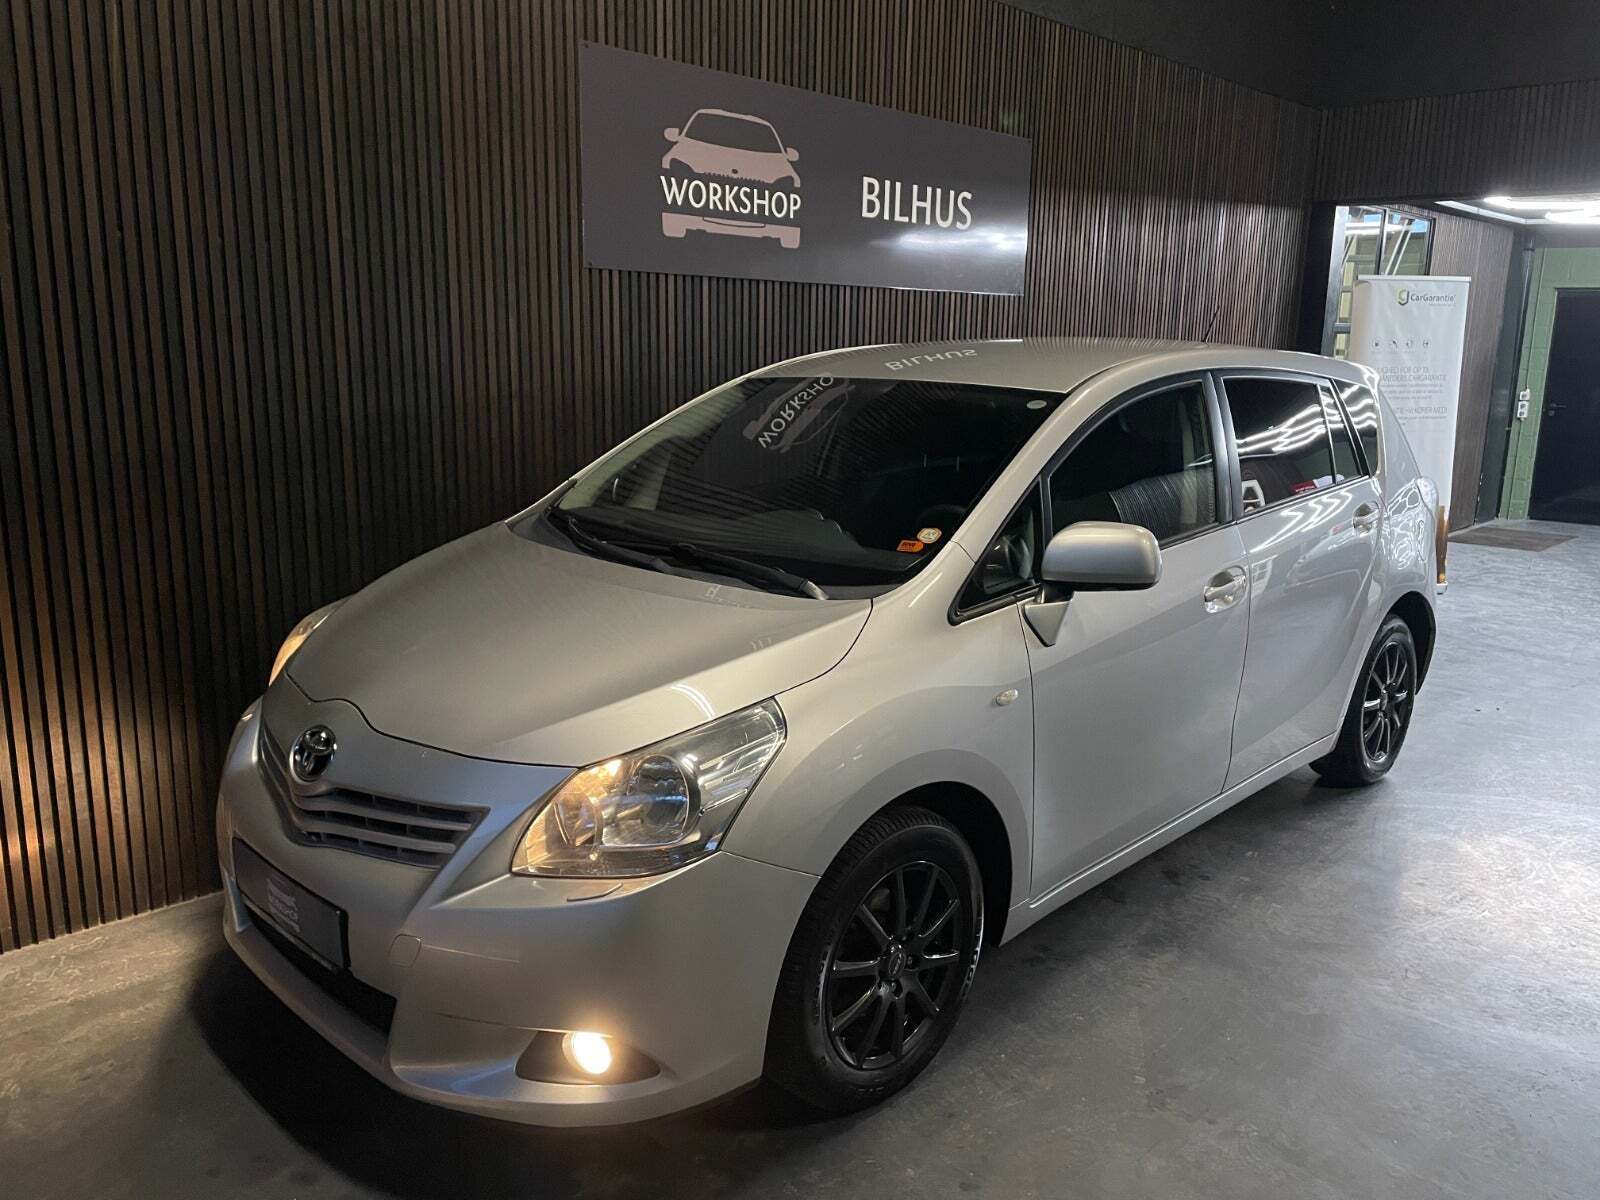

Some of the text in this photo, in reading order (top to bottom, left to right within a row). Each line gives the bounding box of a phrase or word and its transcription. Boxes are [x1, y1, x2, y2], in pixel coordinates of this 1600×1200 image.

[660, 175, 801, 219] WORKSHOP
[861, 176, 973, 230] BILHUS
[1410, 293, 1455, 302] CarGarantie
